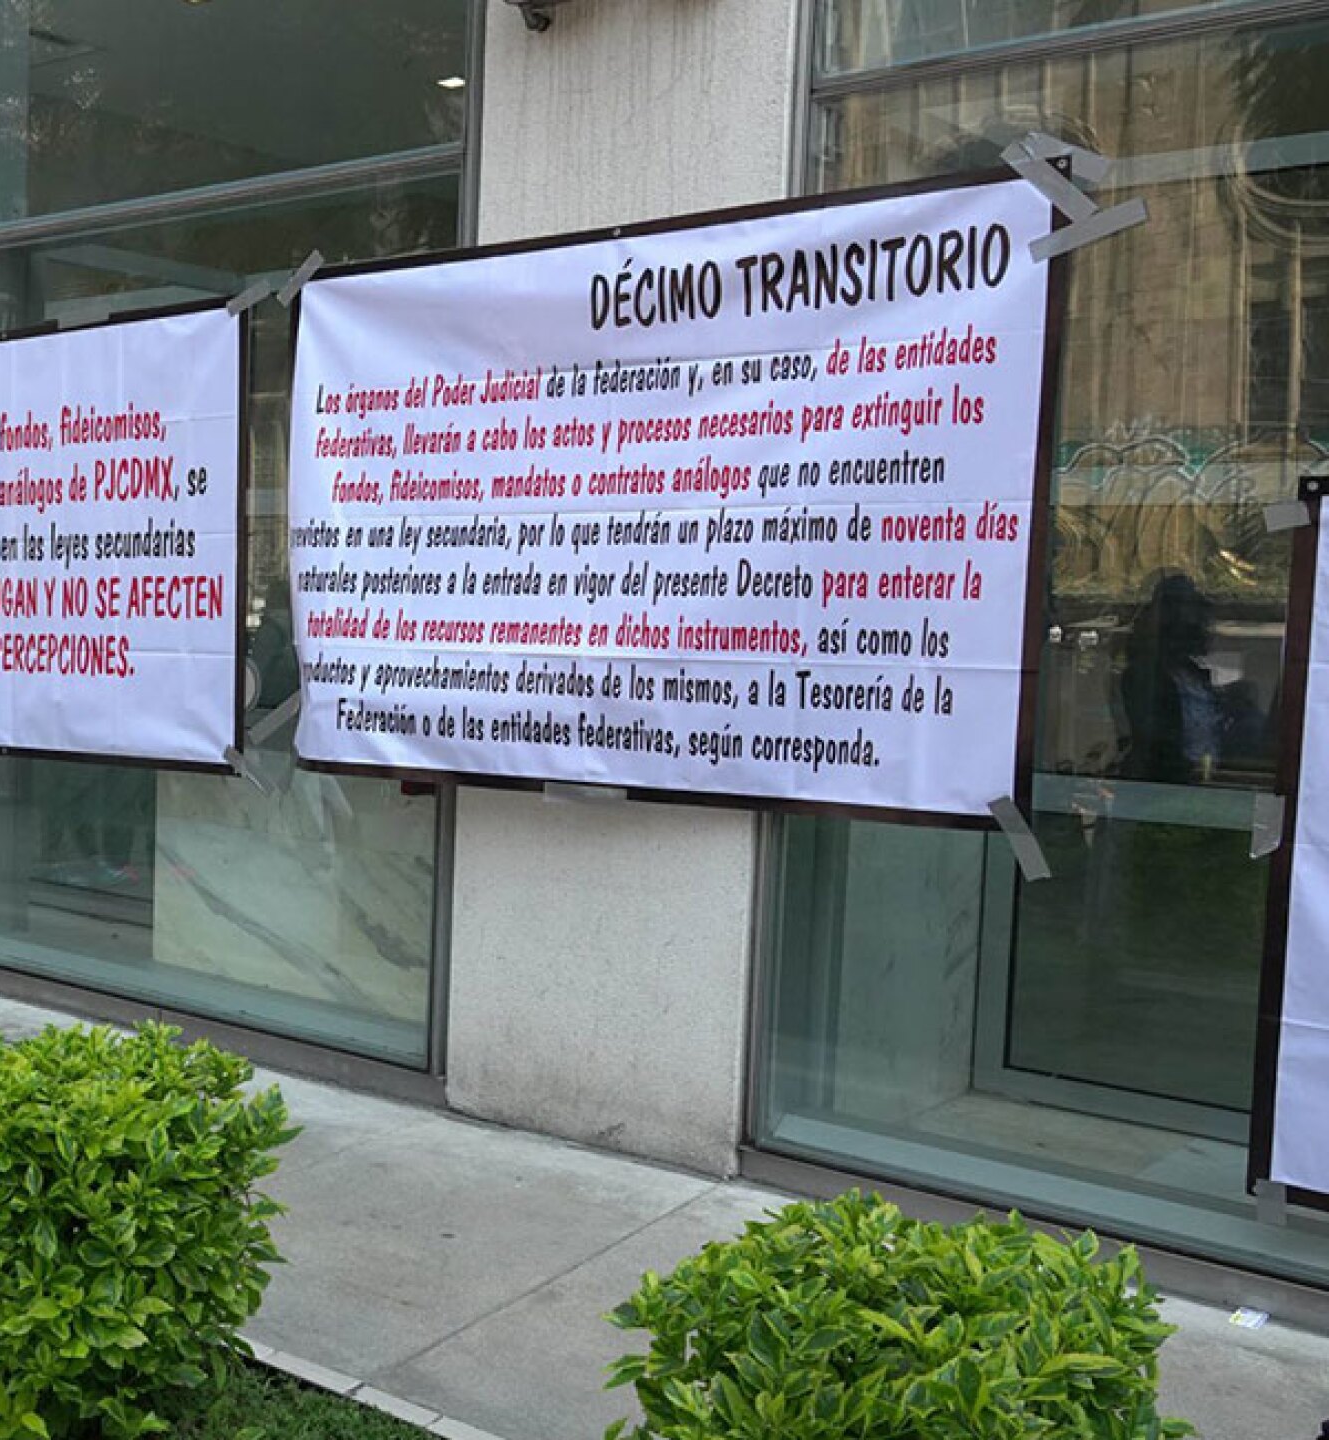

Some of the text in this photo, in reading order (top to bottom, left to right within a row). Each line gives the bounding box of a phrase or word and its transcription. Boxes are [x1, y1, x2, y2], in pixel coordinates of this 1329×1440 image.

[591, 224, 1010, 330] DÉCIMO TRANSITORIO
[316, 323, 996, 420] Los órganos del Poder Judicial de la federación y, en su caso, de las entidades
[0, 410, 53, 452] fondos,
[60, 403, 166, 447] fideicomisos,
[315, 383, 984, 459] federativas, llevarán a cabo los actos y procesos necesarios para extinguir los
[69, 463, 87, 502] de
[95, 456, 180, 502] PJCDMX,
[187, 467, 208, 496] se
[332, 470, 383, 505] fondos,
[390, 469, 485, 503] fideicomisos,
[491, 463, 567, 499] mandatos
[571, 474, 582, 496] o
[587, 463, 665, 496] contratos
[671, 454, 751, 500] análogos
[757, 462, 790, 498] que
[797, 461, 820, 488] no
[0, 534, 18, 562] en
[24, 523, 44, 562] las
[51, 521, 89, 570] leyes
[95, 516, 195, 561] secundarias
[293, 500, 1019, 556] revistos en una ley secundaria, por lo que tendrán un plazo máximo de noventa días
[44, 576, 56, 618] Y
[62, 576, 89, 620] NO
[95, 576, 121, 620] SE
[126, 573, 224, 620] AFECTEN
[361, 564, 441, 601] posteriores
[447, 572, 457, 594] a
[462, 562, 476, 596] la
[483, 561, 542, 596] entrada
[547, 573, 567, 596] en
[574, 563, 616, 605] vigor
[620, 560, 649, 596] del
[652, 565, 729, 607] presente
[736, 558, 813, 598] Decreto
[822, 569, 868, 609] para
[877, 565, 955, 600] enterar
[963, 559, 981, 600] la
[308, 607, 948, 658] totalidad de los recursos remanentes en dichos instrumentos, así como los
[359, 664, 371, 693] y
[374, 655, 510, 695] aprovechamientos
[516, 660, 594, 698] derivados
[602, 662, 621, 698] de
[629, 664, 655, 700] los
[663, 668, 739, 709] mismos,
[748, 680, 760, 706] a
[768, 669, 786, 707] la
[795, 669, 893, 712] Tesorería
[901, 673, 924, 713] de
[934, 674, 953, 715] la
[337, 698, 879, 773] Federación o de las entidades federativas, según corresponda.
